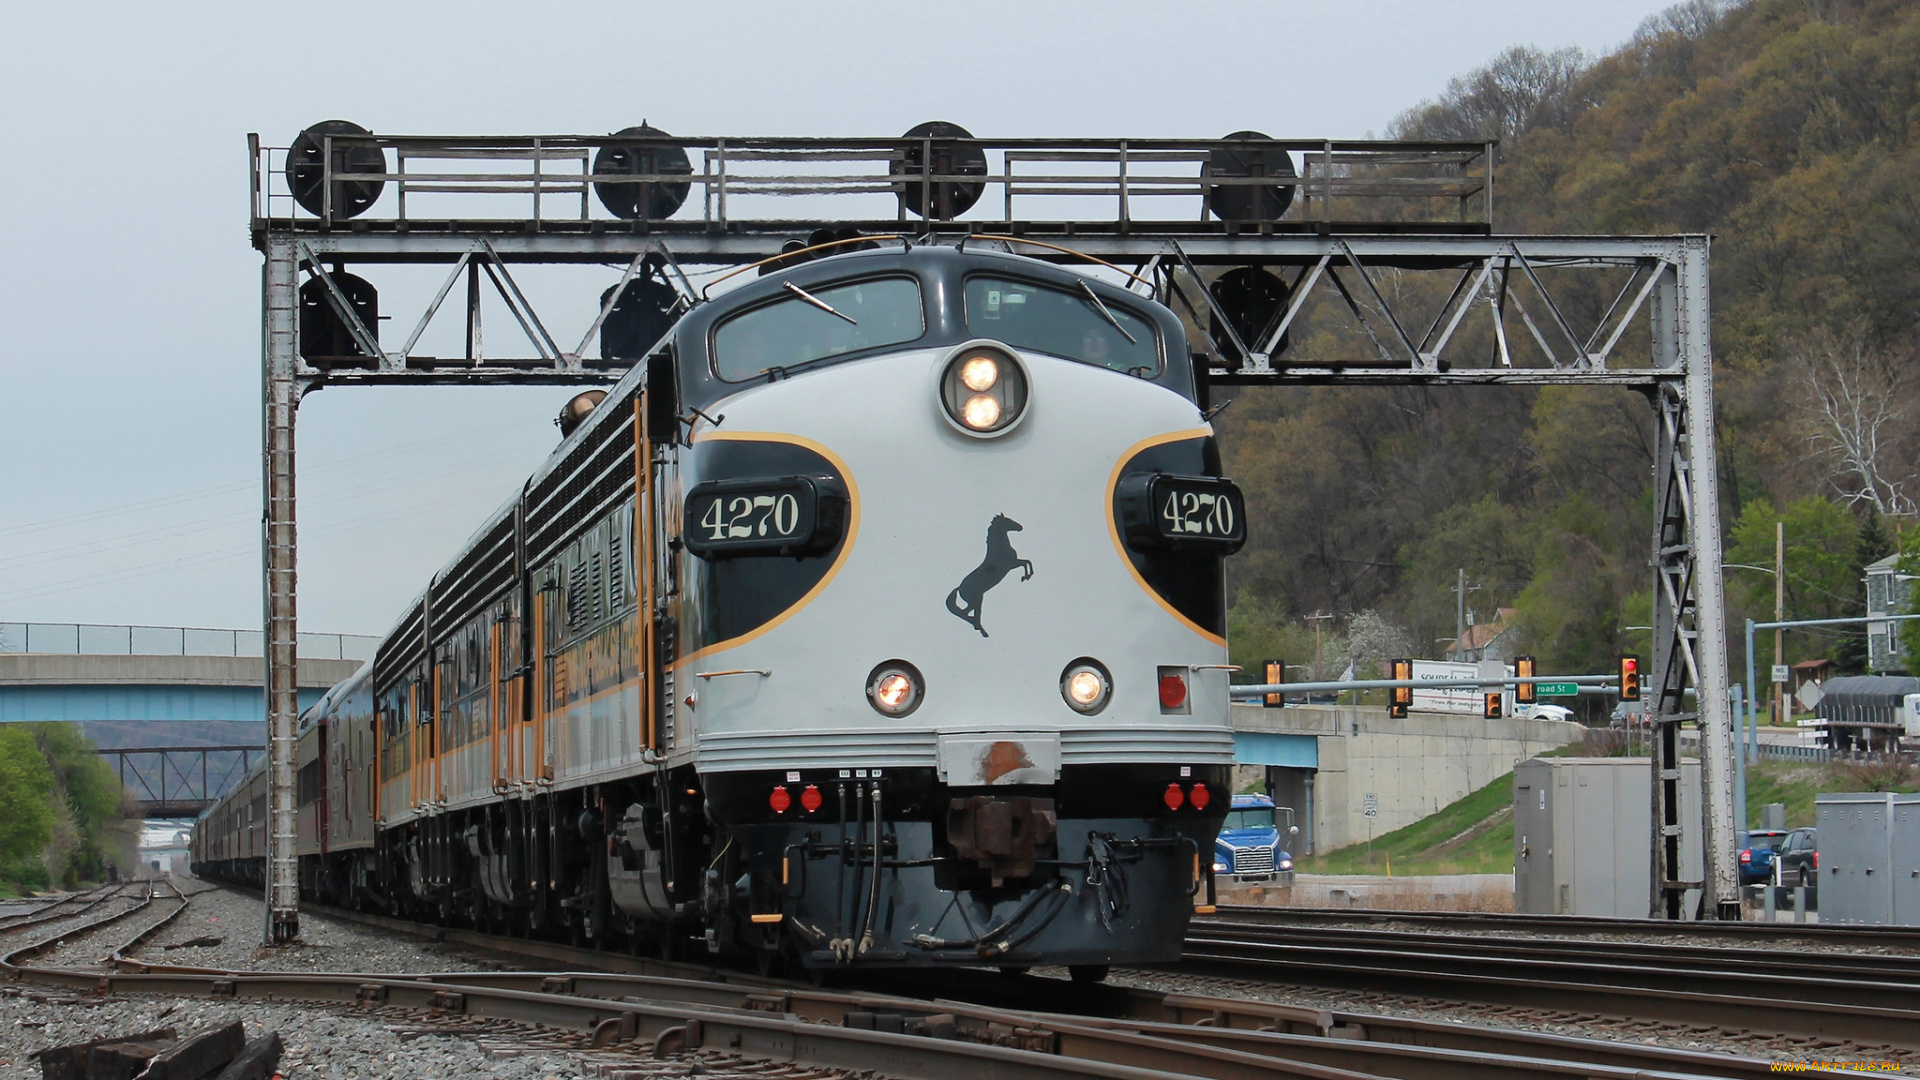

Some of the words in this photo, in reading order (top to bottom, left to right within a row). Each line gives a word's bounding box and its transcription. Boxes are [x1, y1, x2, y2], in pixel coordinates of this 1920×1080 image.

[701, 493, 799, 540] 4270
[1163, 491, 1234, 535] 4270
[1365, 809, 1377, 817] 40
